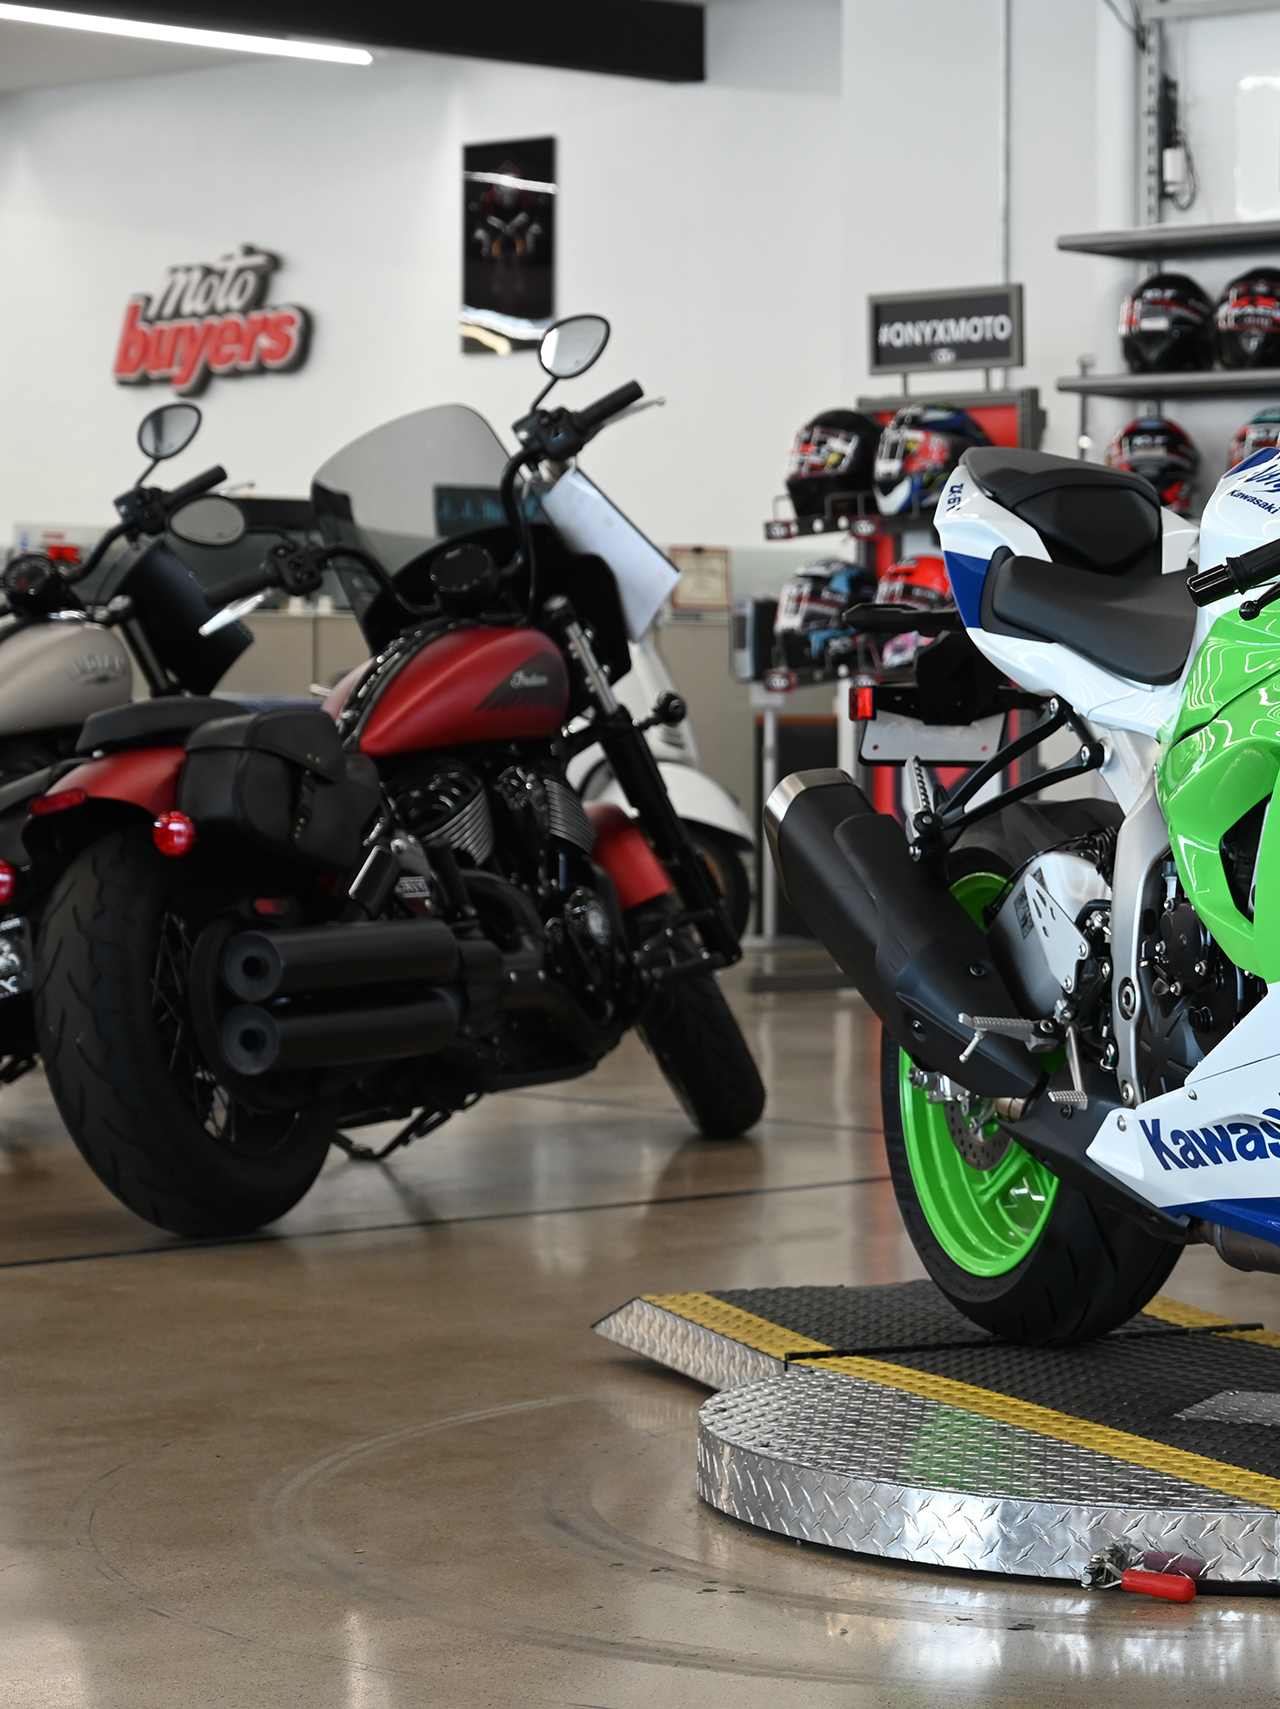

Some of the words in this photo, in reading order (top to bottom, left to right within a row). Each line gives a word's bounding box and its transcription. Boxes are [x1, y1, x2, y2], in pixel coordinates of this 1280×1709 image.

[147, 250, 270, 320] Moto
[112, 298, 299, 388] buyers
[878, 314, 1012, 348] #ONYXMOTO
